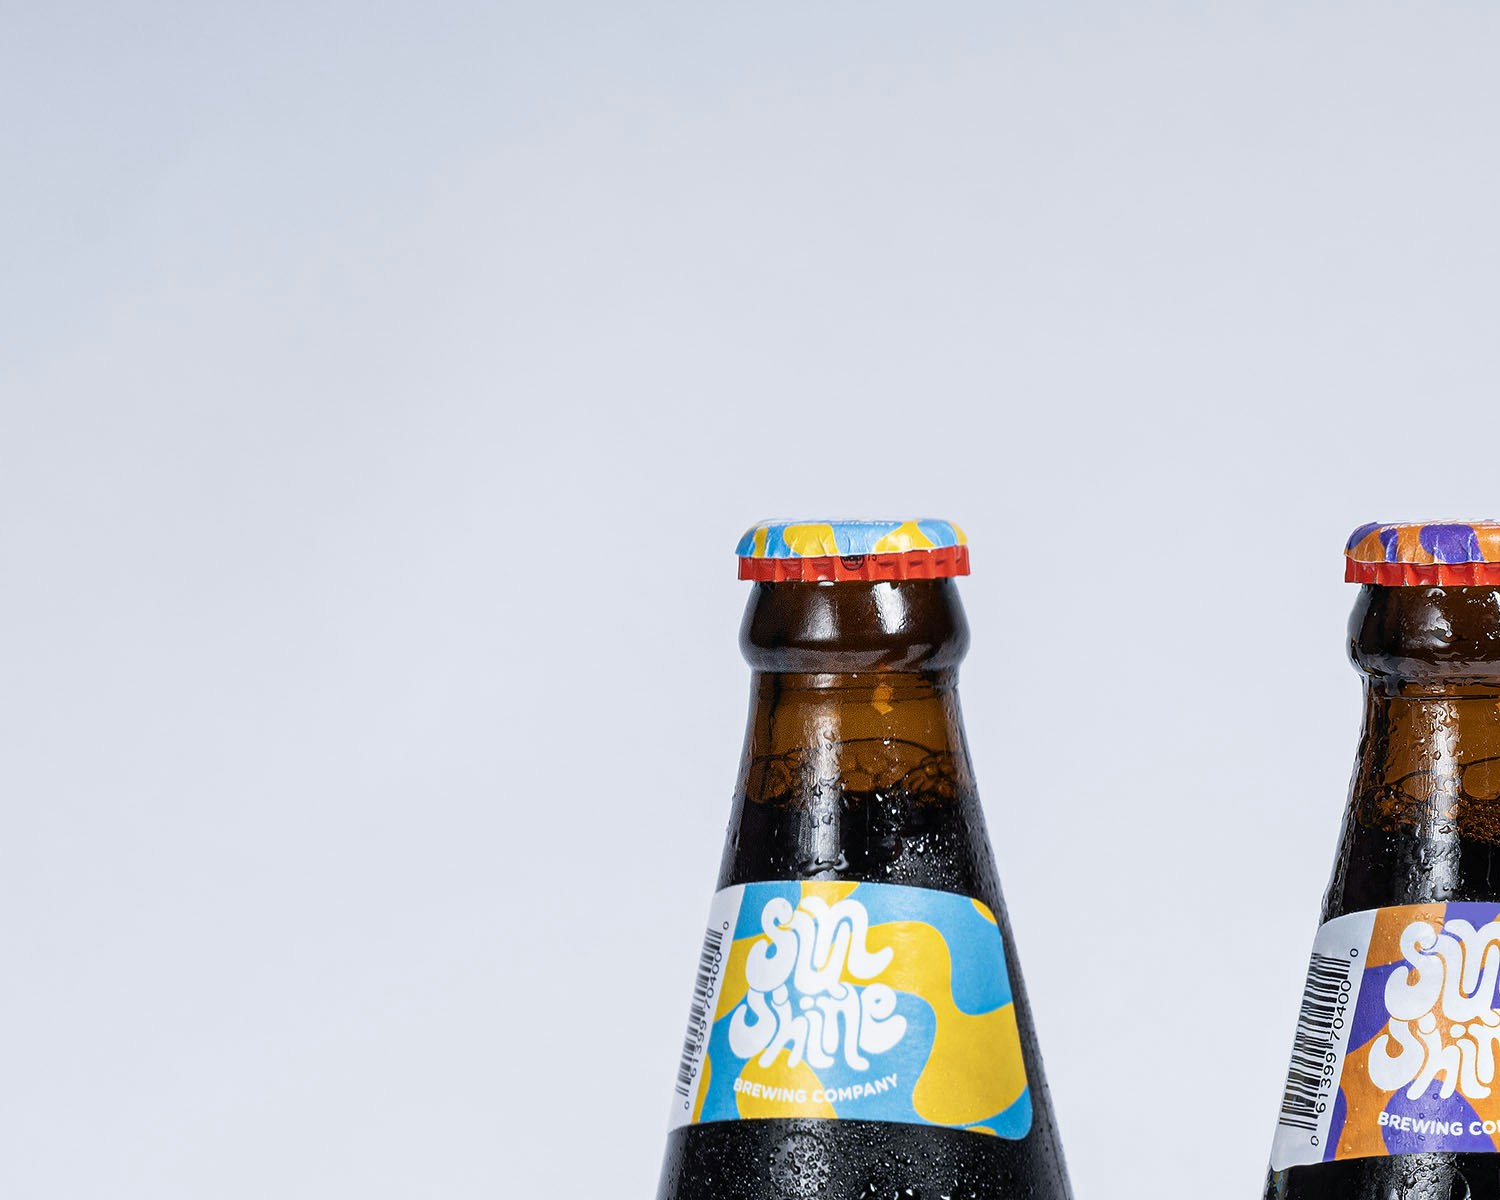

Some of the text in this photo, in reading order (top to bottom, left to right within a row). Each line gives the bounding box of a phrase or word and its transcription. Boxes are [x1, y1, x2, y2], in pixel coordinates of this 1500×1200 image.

[1315, 1052, 1336, 1113] 61399
[1329, 980, 1351, 1041] 70400
[1350, 948, 1359, 958] 0
[733, 1073, 898, 1104] BREWING COMPANY
[1377, 1111, 1463, 1136] BREWING
